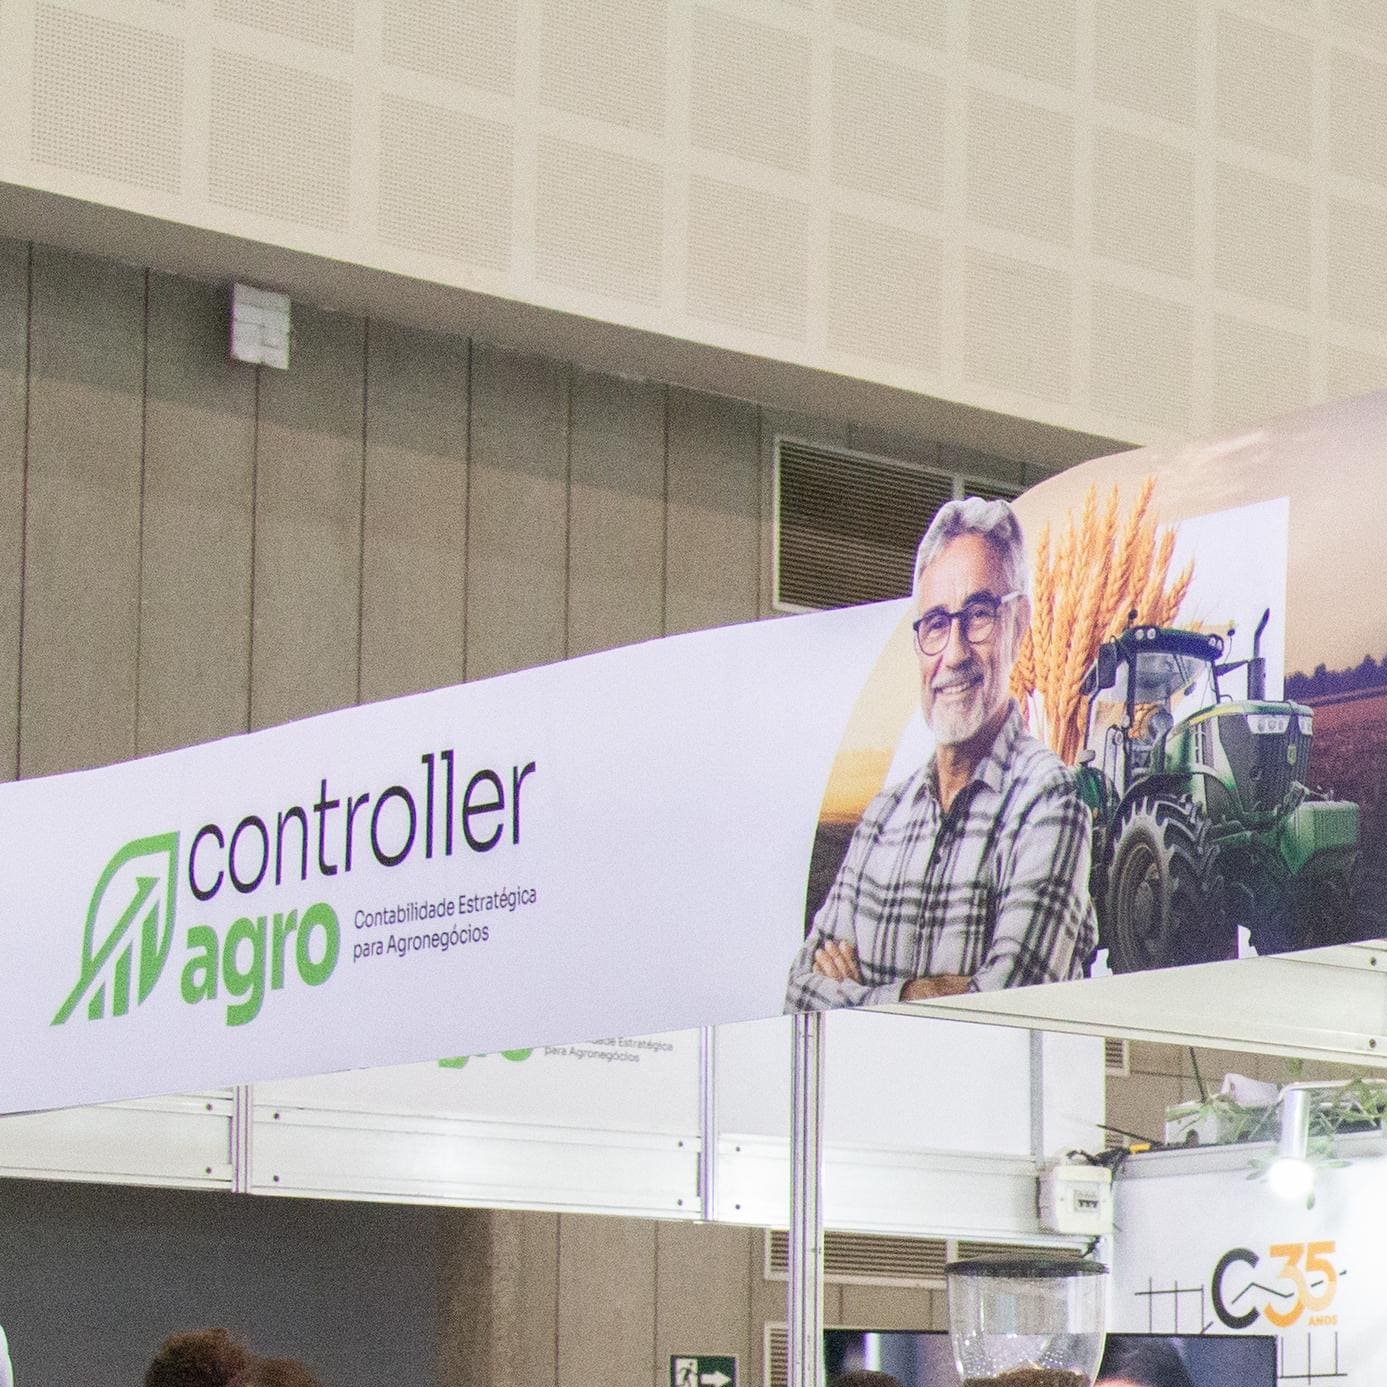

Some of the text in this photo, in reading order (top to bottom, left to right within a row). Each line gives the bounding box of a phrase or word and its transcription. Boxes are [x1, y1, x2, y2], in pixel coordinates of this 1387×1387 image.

[188, 749, 536, 901] controller
[353, 884, 538, 931] Contabilidade Estratégica
[353, 920, 490, 961] para Agronegócios
[180, 902, 341, 1027] agro
